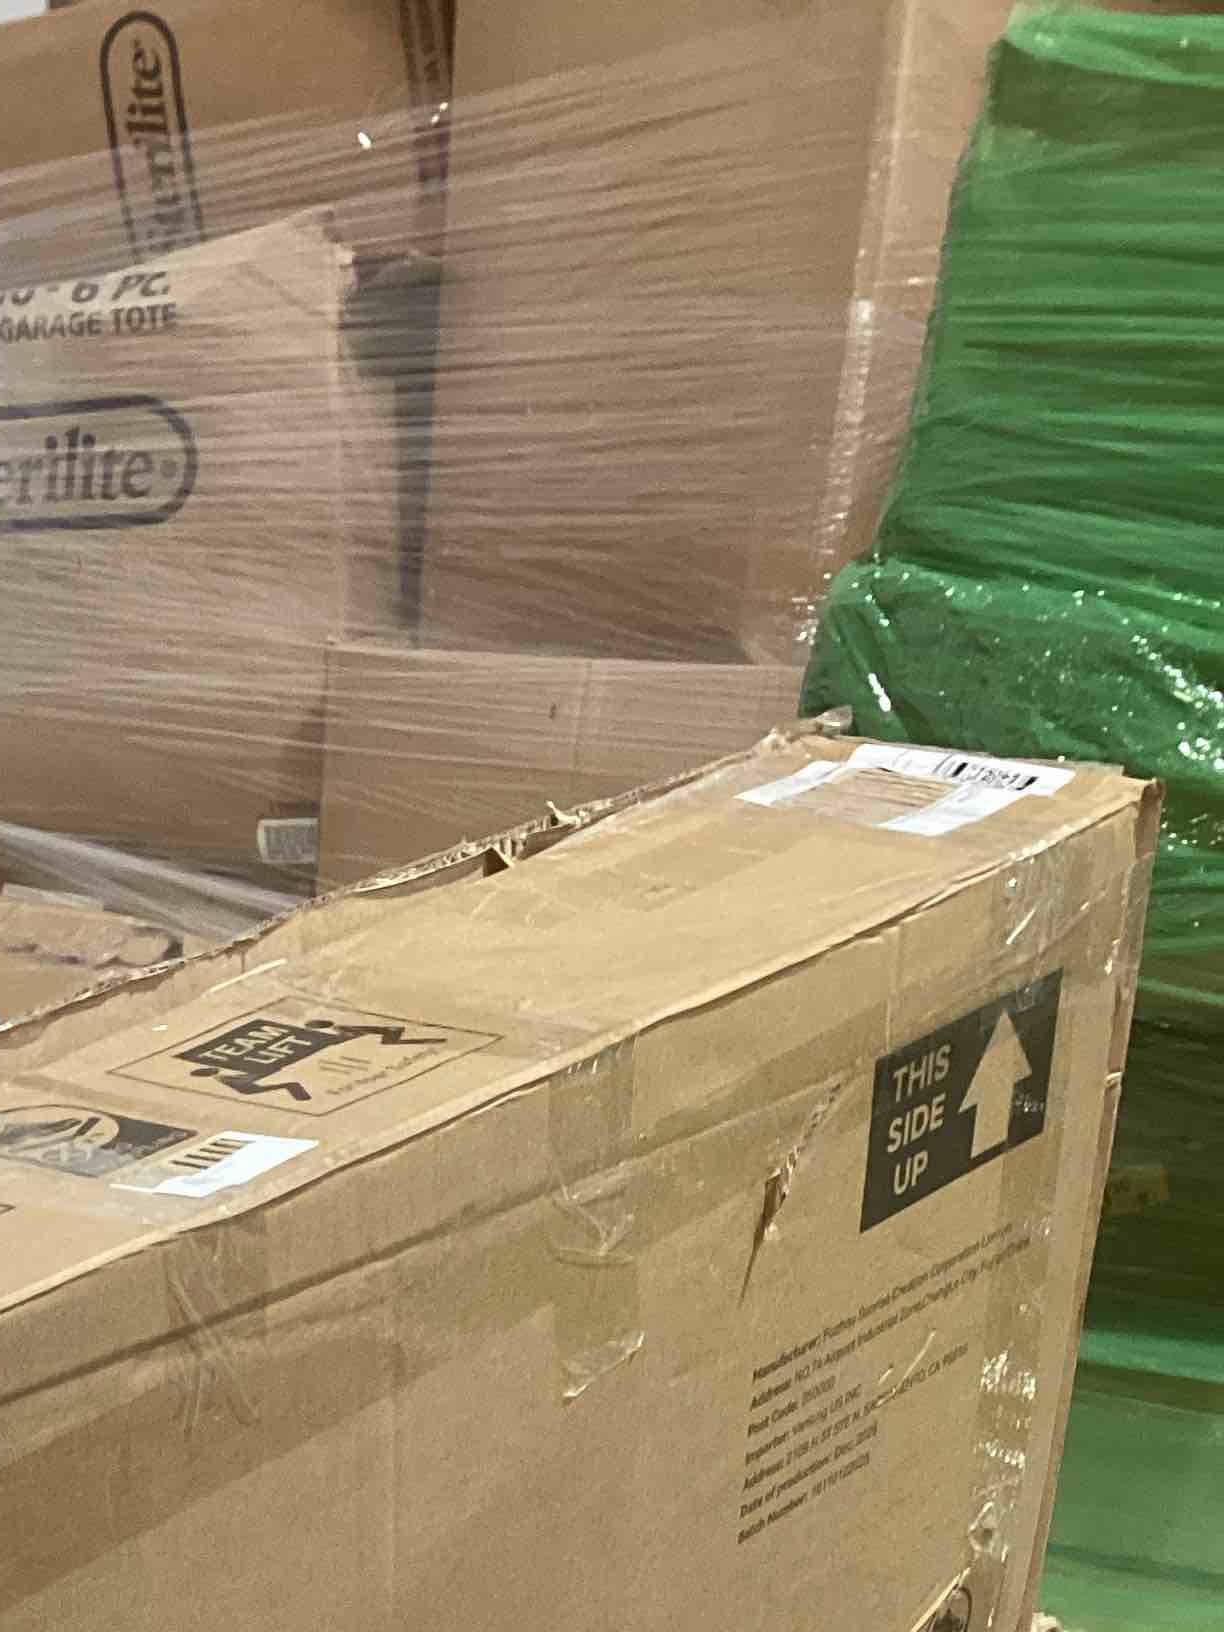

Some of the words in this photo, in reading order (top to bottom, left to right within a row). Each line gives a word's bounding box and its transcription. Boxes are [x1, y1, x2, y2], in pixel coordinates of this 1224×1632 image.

[112, 302, 177, 336] TOTE
[197, 1023, 290, 1062] TEAM
[243, 1035, 313, 1065] LIFT
[891, 1042, 953, 1103] THIS
[886, 1093, 946, 1154] SIDE
[892, 1150, 929, 1198] UP
